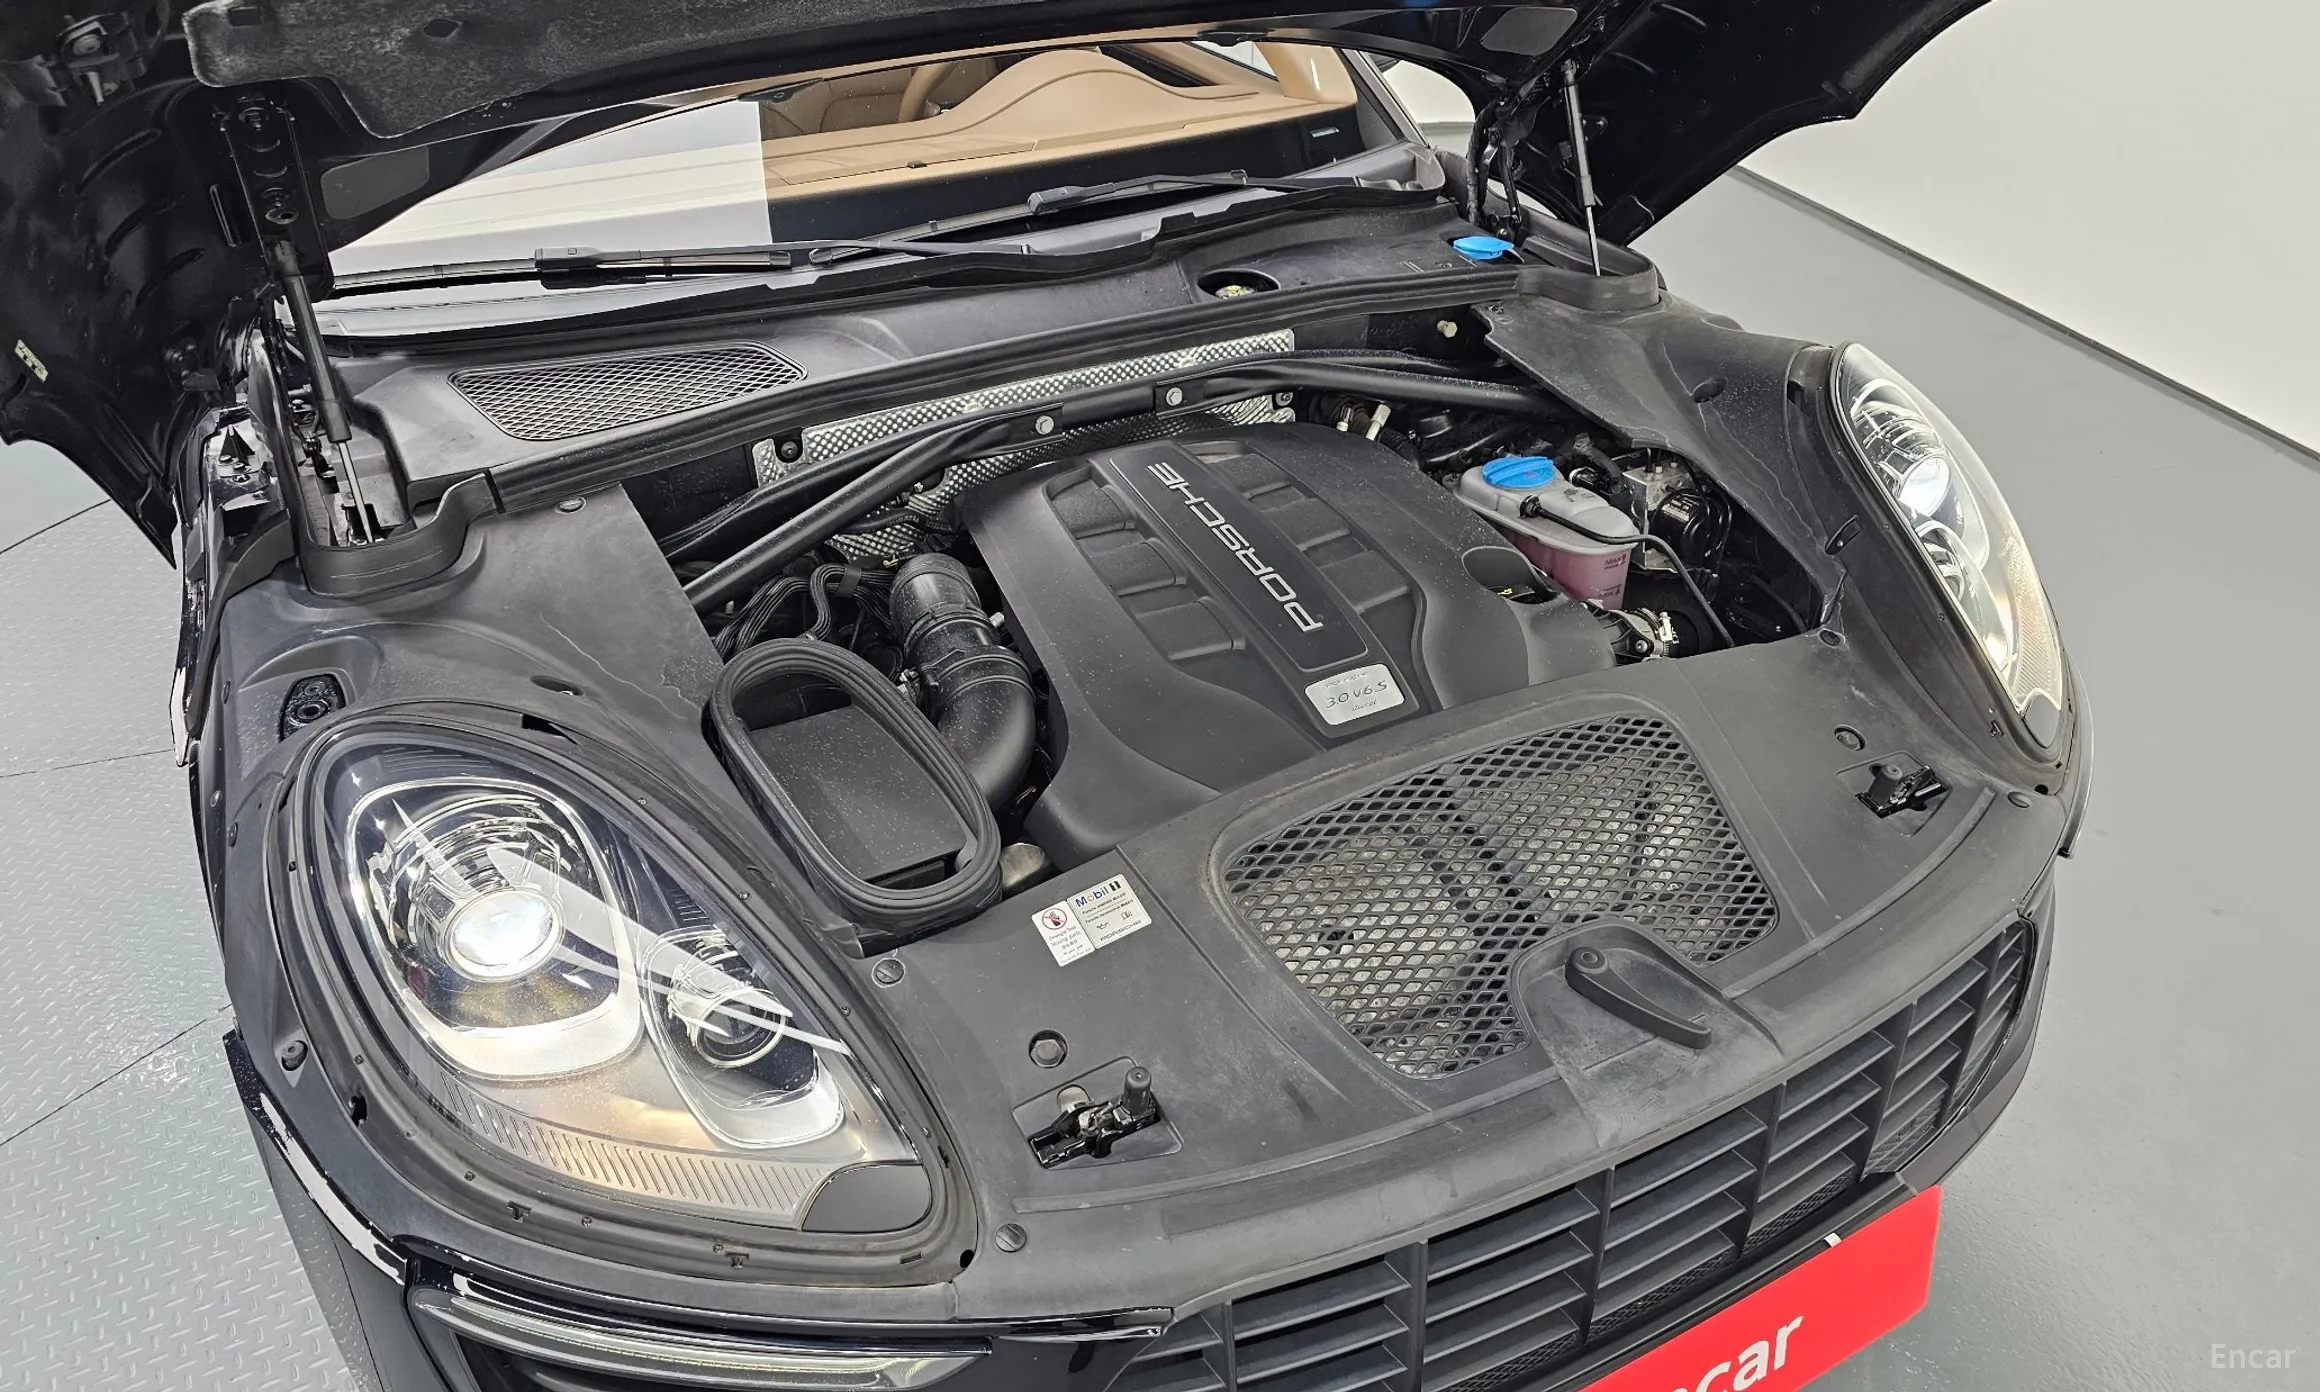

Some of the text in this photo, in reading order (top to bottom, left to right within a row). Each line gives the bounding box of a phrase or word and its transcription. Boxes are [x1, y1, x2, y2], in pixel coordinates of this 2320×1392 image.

[1147, 462, 1324, 632] PORSCHE
[1325, 692, 1350, 709] 3.0
[1075, 886, 1110, 908] Mobil
[1672, 1315, 1804, 1392] car
